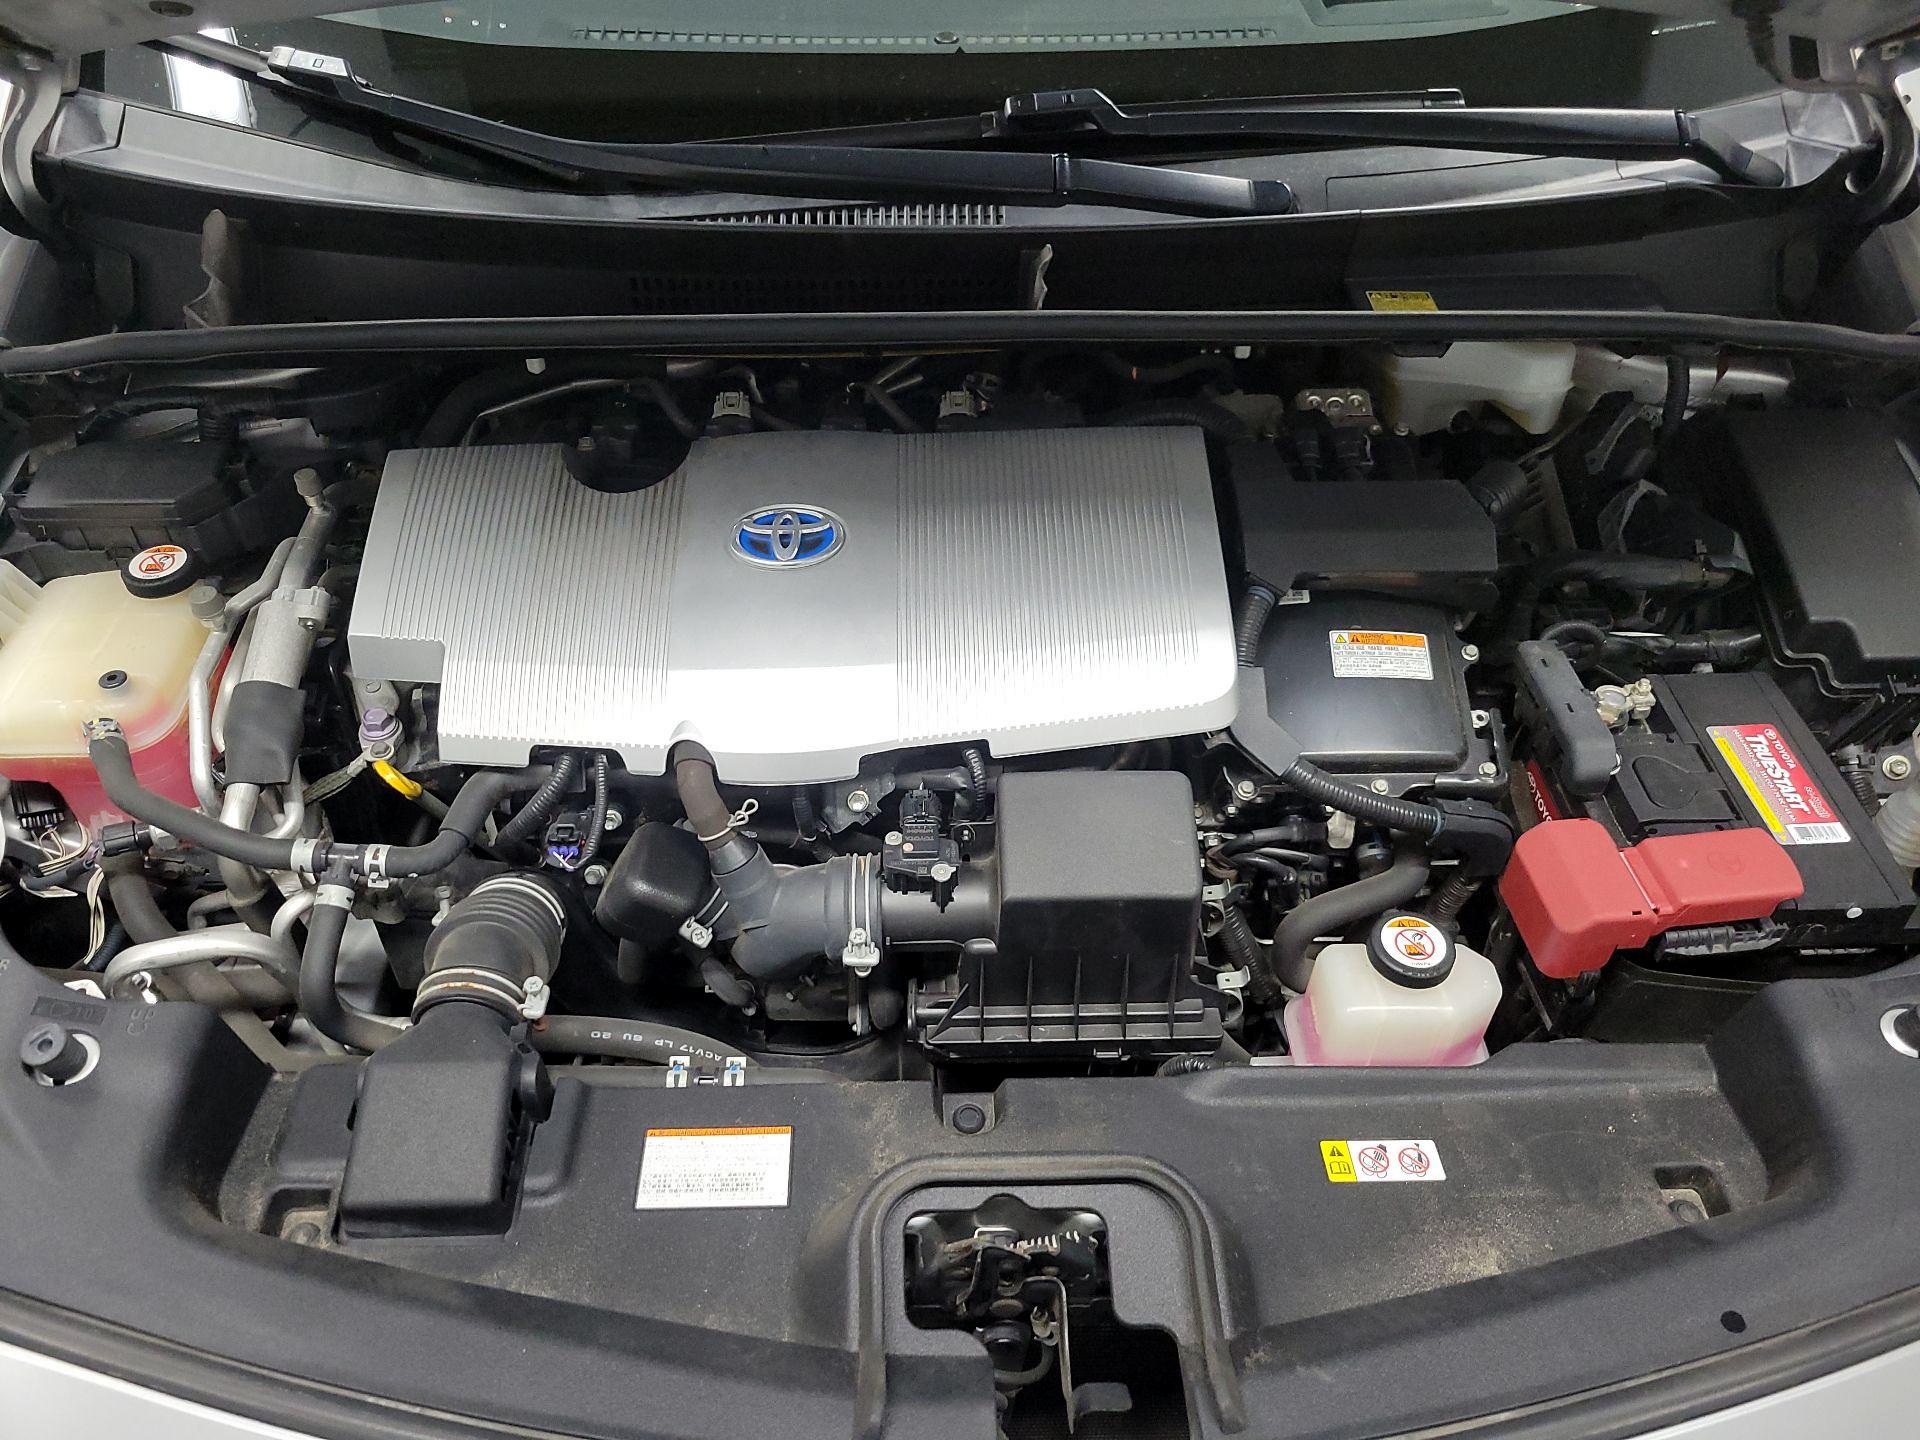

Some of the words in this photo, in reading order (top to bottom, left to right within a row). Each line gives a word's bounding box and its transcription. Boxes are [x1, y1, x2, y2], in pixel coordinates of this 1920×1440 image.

[1772, 739, 1796, 769] TOYOTA
[654, 1038, 675, 1049] LP
[679, 1043, 722, 1062] ACV17
